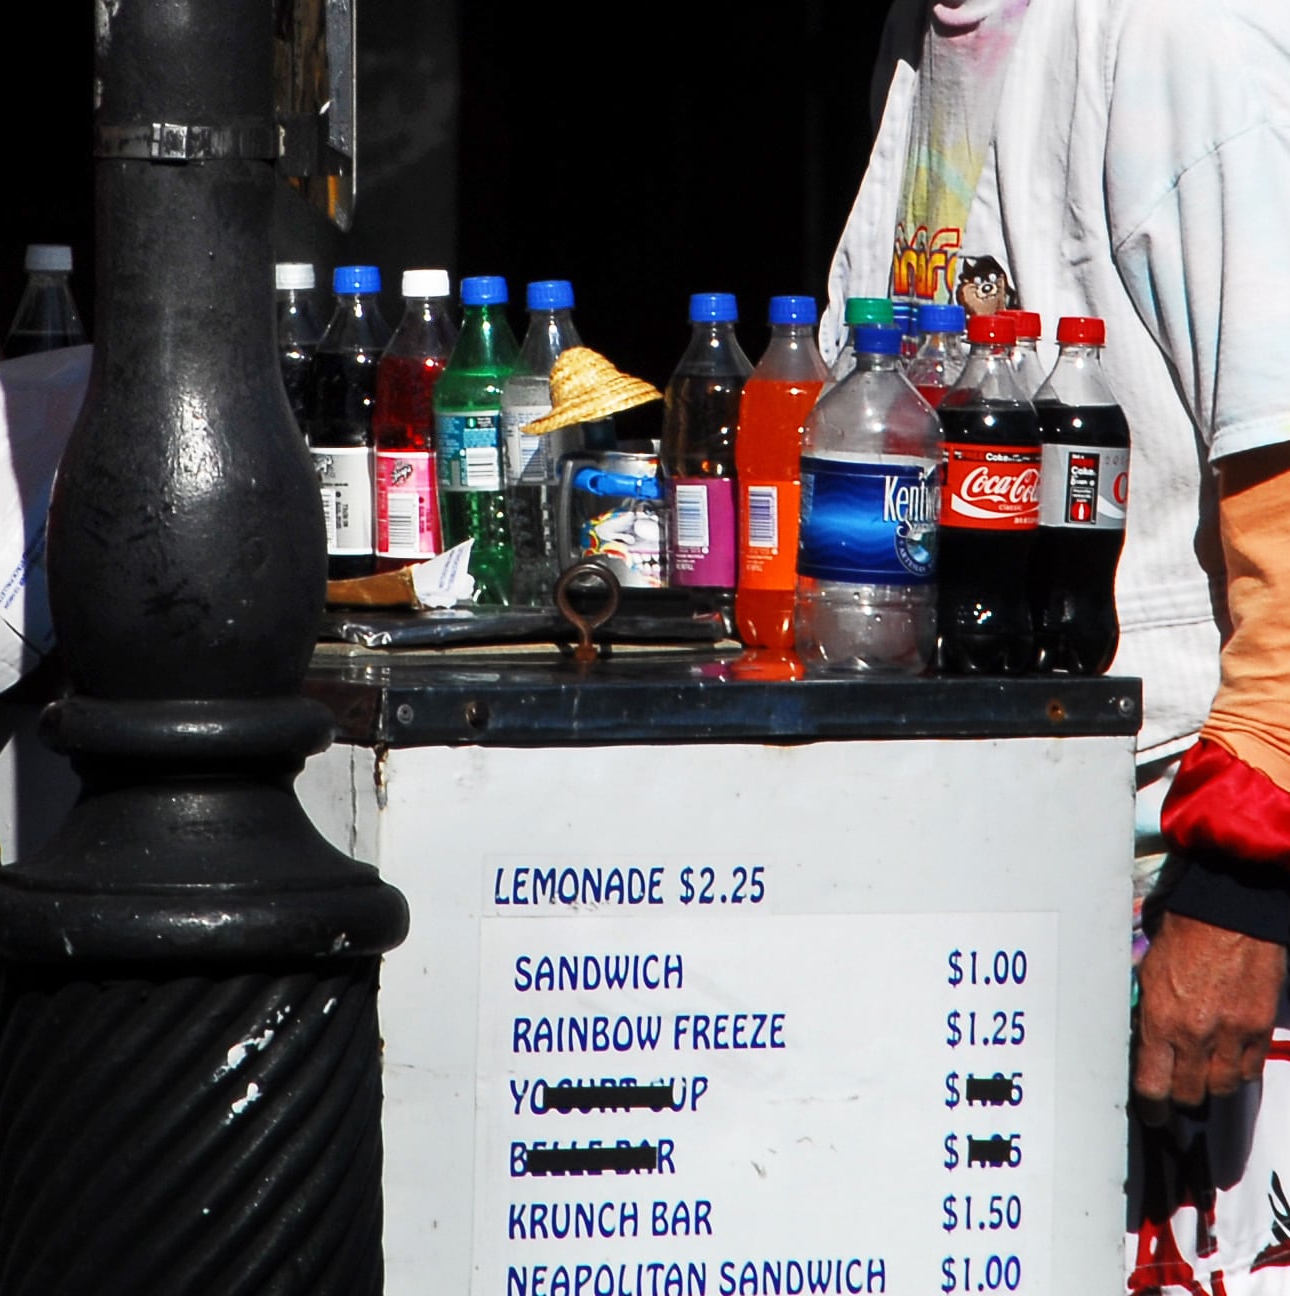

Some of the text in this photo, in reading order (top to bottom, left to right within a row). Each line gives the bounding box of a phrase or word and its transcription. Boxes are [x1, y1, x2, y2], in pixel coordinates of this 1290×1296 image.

[494, 866, 766, 905] LEMONADE $2.25
[514, 949, 1027, 992] SANDWICH $1.00
[513, 1010, 1025, 1053] RAINBOW FREEZE $1.25
[508, 1194, 1022, 1240] KRUNCH BAR $1.50
[507, 1255, 1021, 1296] NEAPOLITAN SANDWICH $1.00
